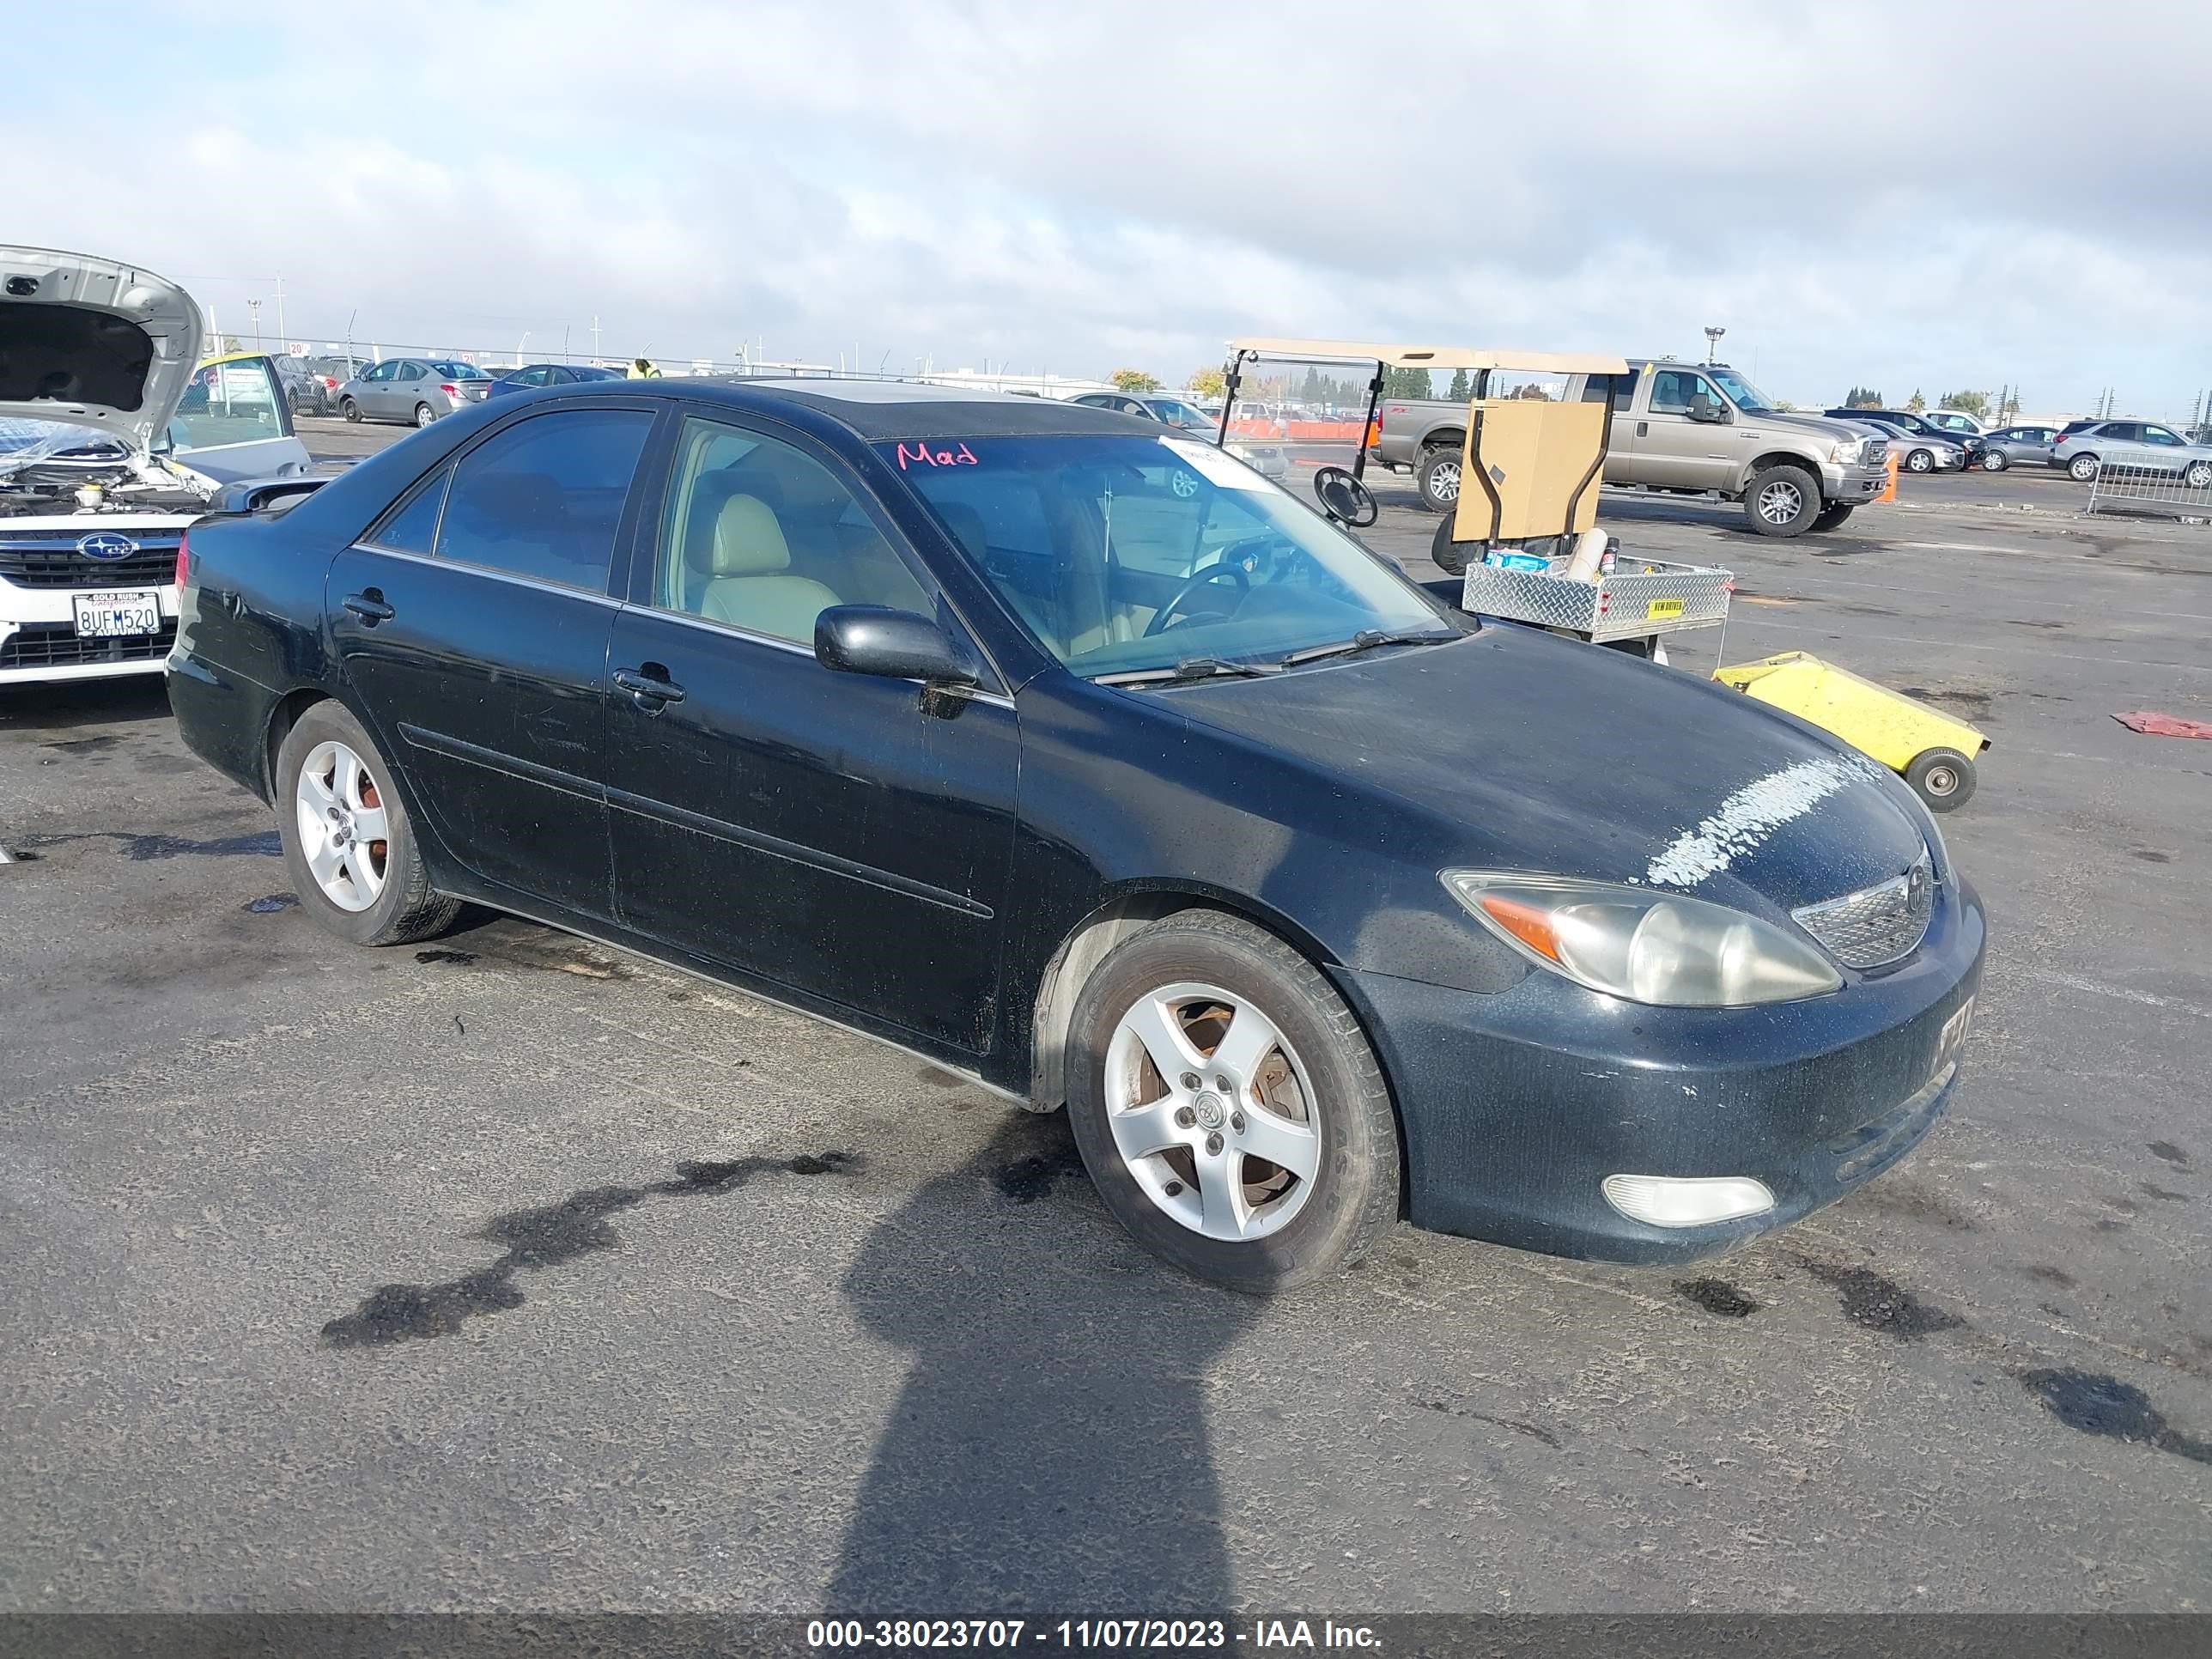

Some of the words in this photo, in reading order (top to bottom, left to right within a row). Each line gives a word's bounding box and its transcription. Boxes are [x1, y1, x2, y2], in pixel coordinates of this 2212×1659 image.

[291, 344, 302, 354] 20
[81, 609, 155, 630] 8UFM520
[96, 628, 143, 636] AUBURN
